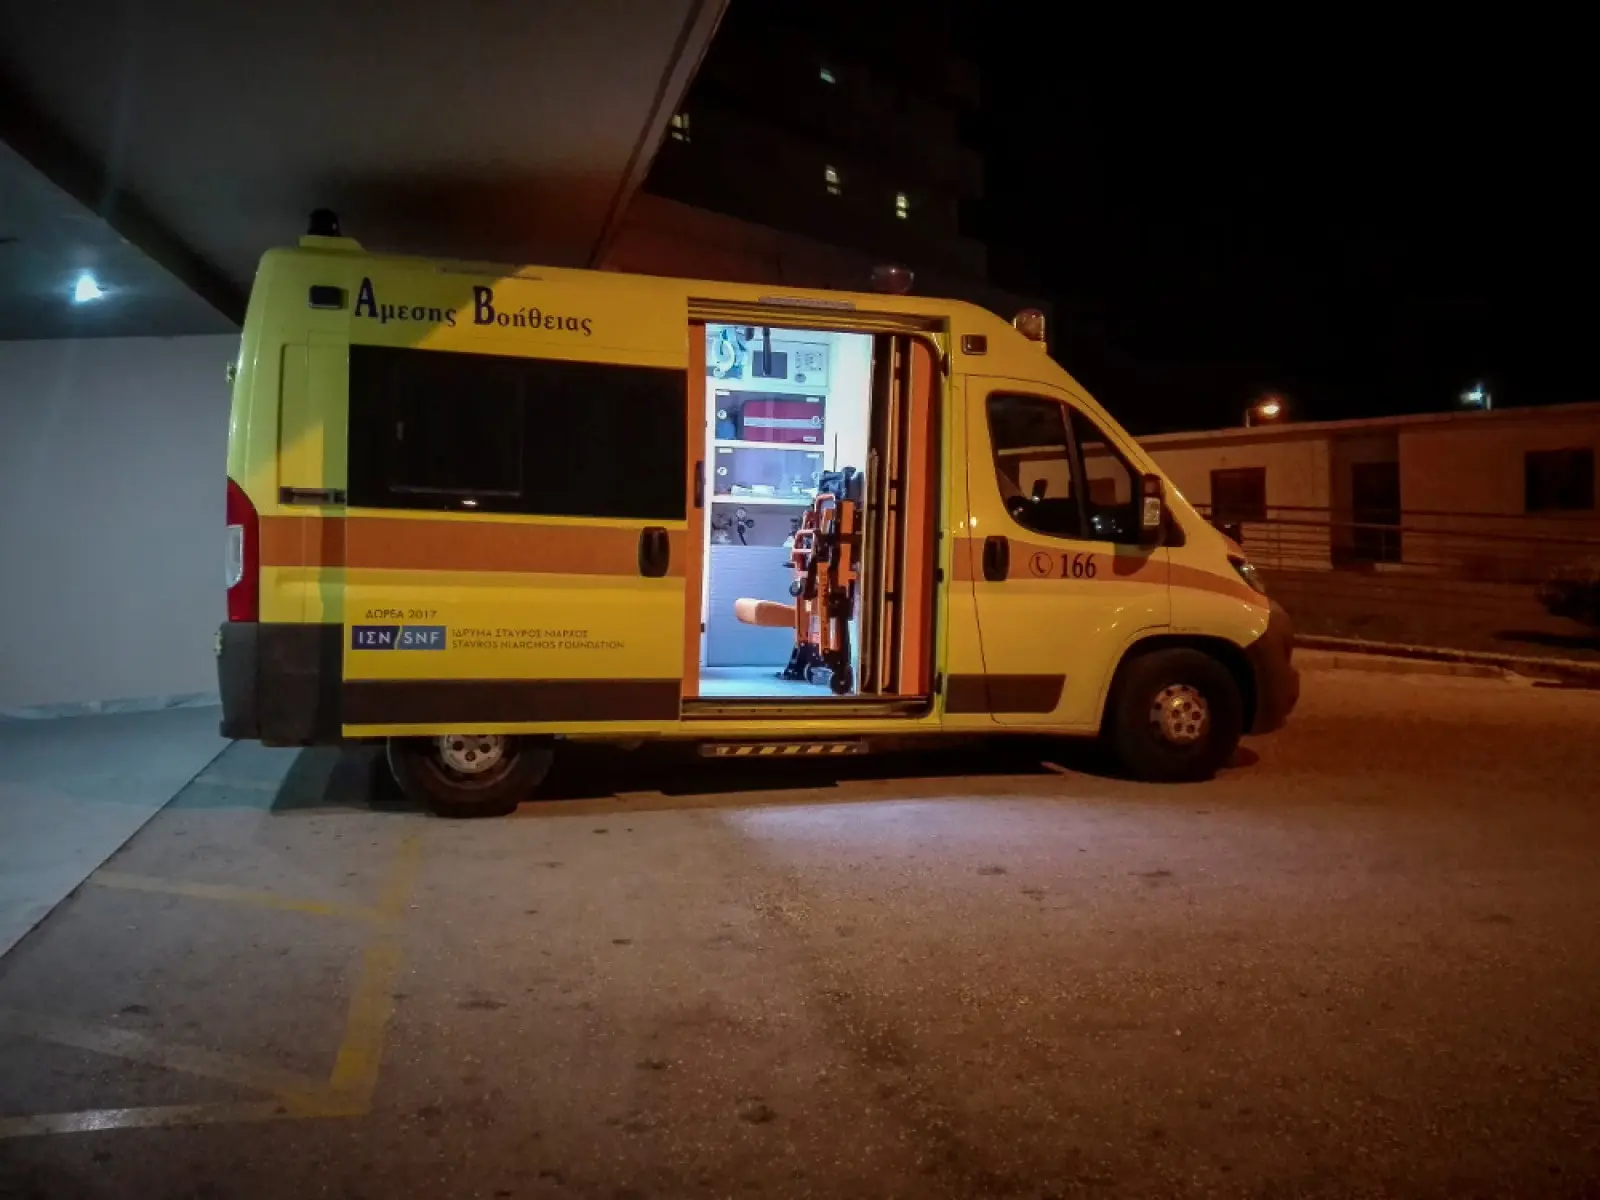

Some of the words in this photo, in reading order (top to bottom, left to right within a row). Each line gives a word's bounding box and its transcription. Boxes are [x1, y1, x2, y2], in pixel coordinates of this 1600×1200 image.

[354, 276, 457, 327] Αμεσης
[473, 285, 593, 336] Βοήθειας
[1060, 552, 1097, 579] 166
[408, 609, 438, 620] 2017
[403, 631, 441, 645] SNF
